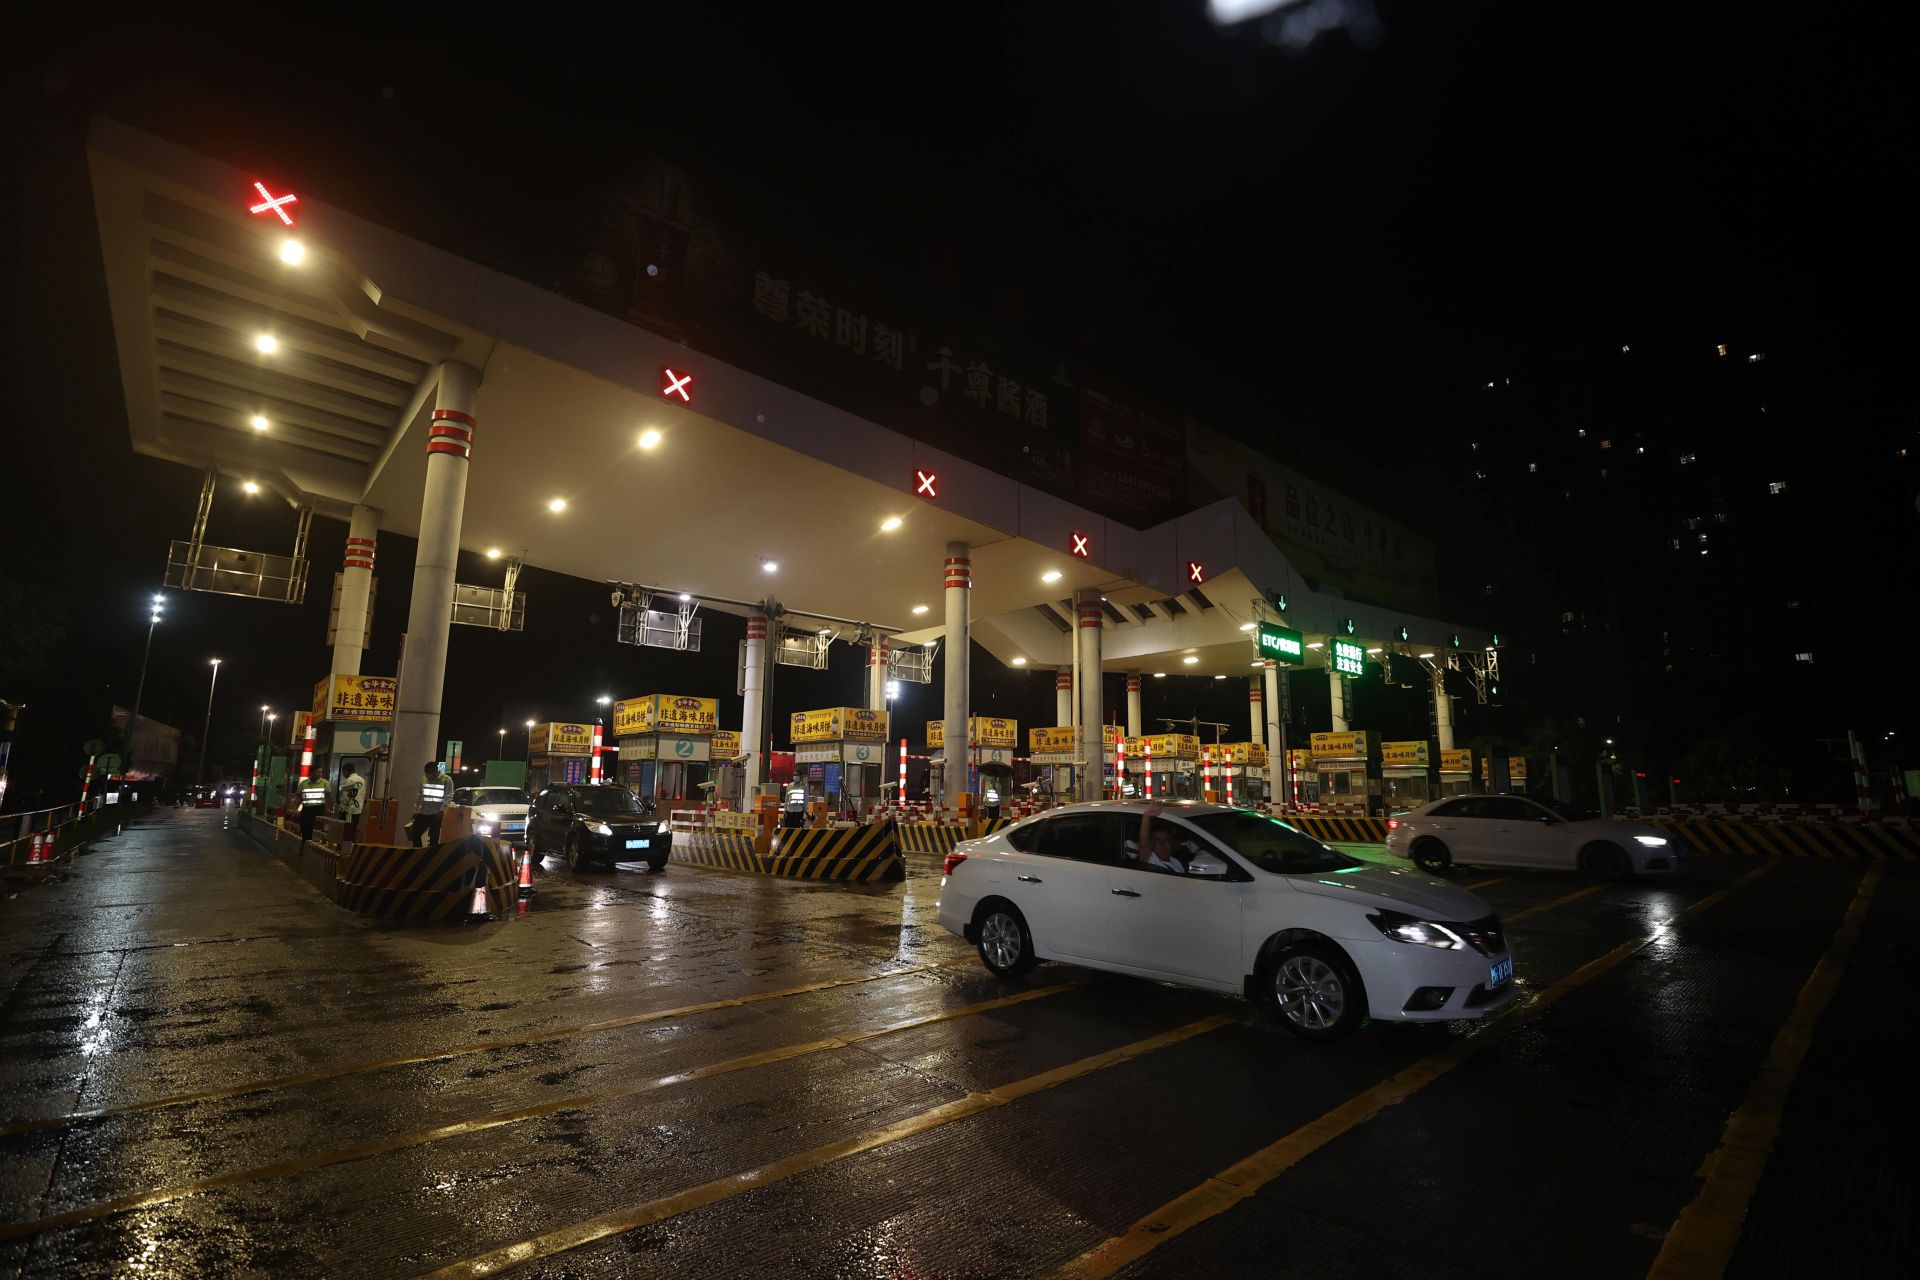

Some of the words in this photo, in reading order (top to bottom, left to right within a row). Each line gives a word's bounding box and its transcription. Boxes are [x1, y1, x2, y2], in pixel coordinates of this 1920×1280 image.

[753, 268, 904, 371] 尊荣时刻
[926, 345, 1048, 431] 千尊酱酒
[336, 691, 393, 709] 非遗海味
[659, 707, 716, 723] 非遗海味月饼
[794, 720, 832, 735] 非遗海味月饼
[845, 719, 887, 733] 非遗海味月饼
[677, 741, 690, 757] 2
